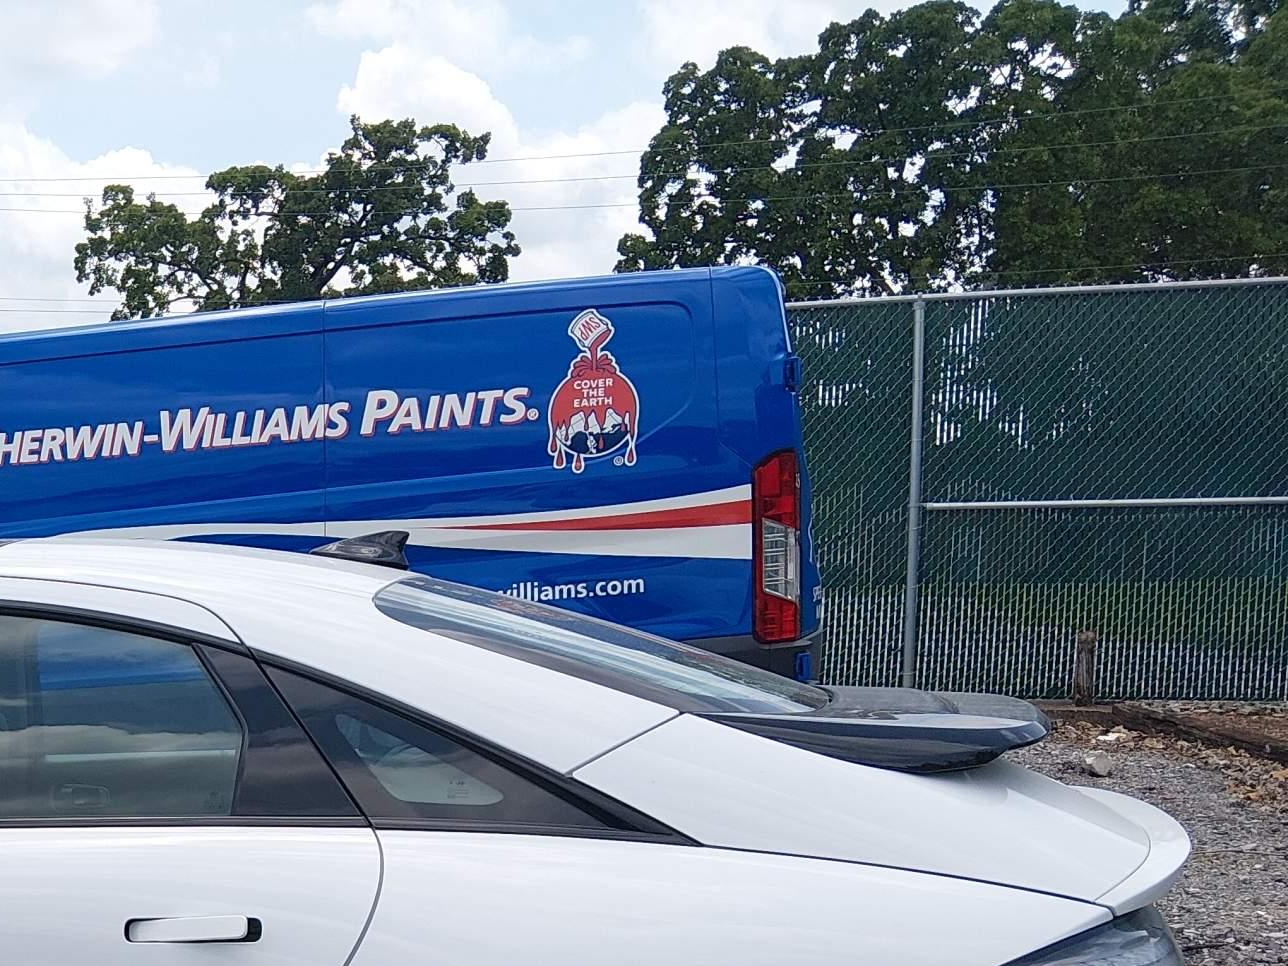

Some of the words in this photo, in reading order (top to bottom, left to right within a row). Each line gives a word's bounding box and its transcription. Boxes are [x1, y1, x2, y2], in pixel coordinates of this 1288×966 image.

[573, 378, 613, 390] COVER
[582, 388, 605, 397] THE
[573, 397, 613, 408] EARTH
[497, 578, 645, 602] illiams.com
